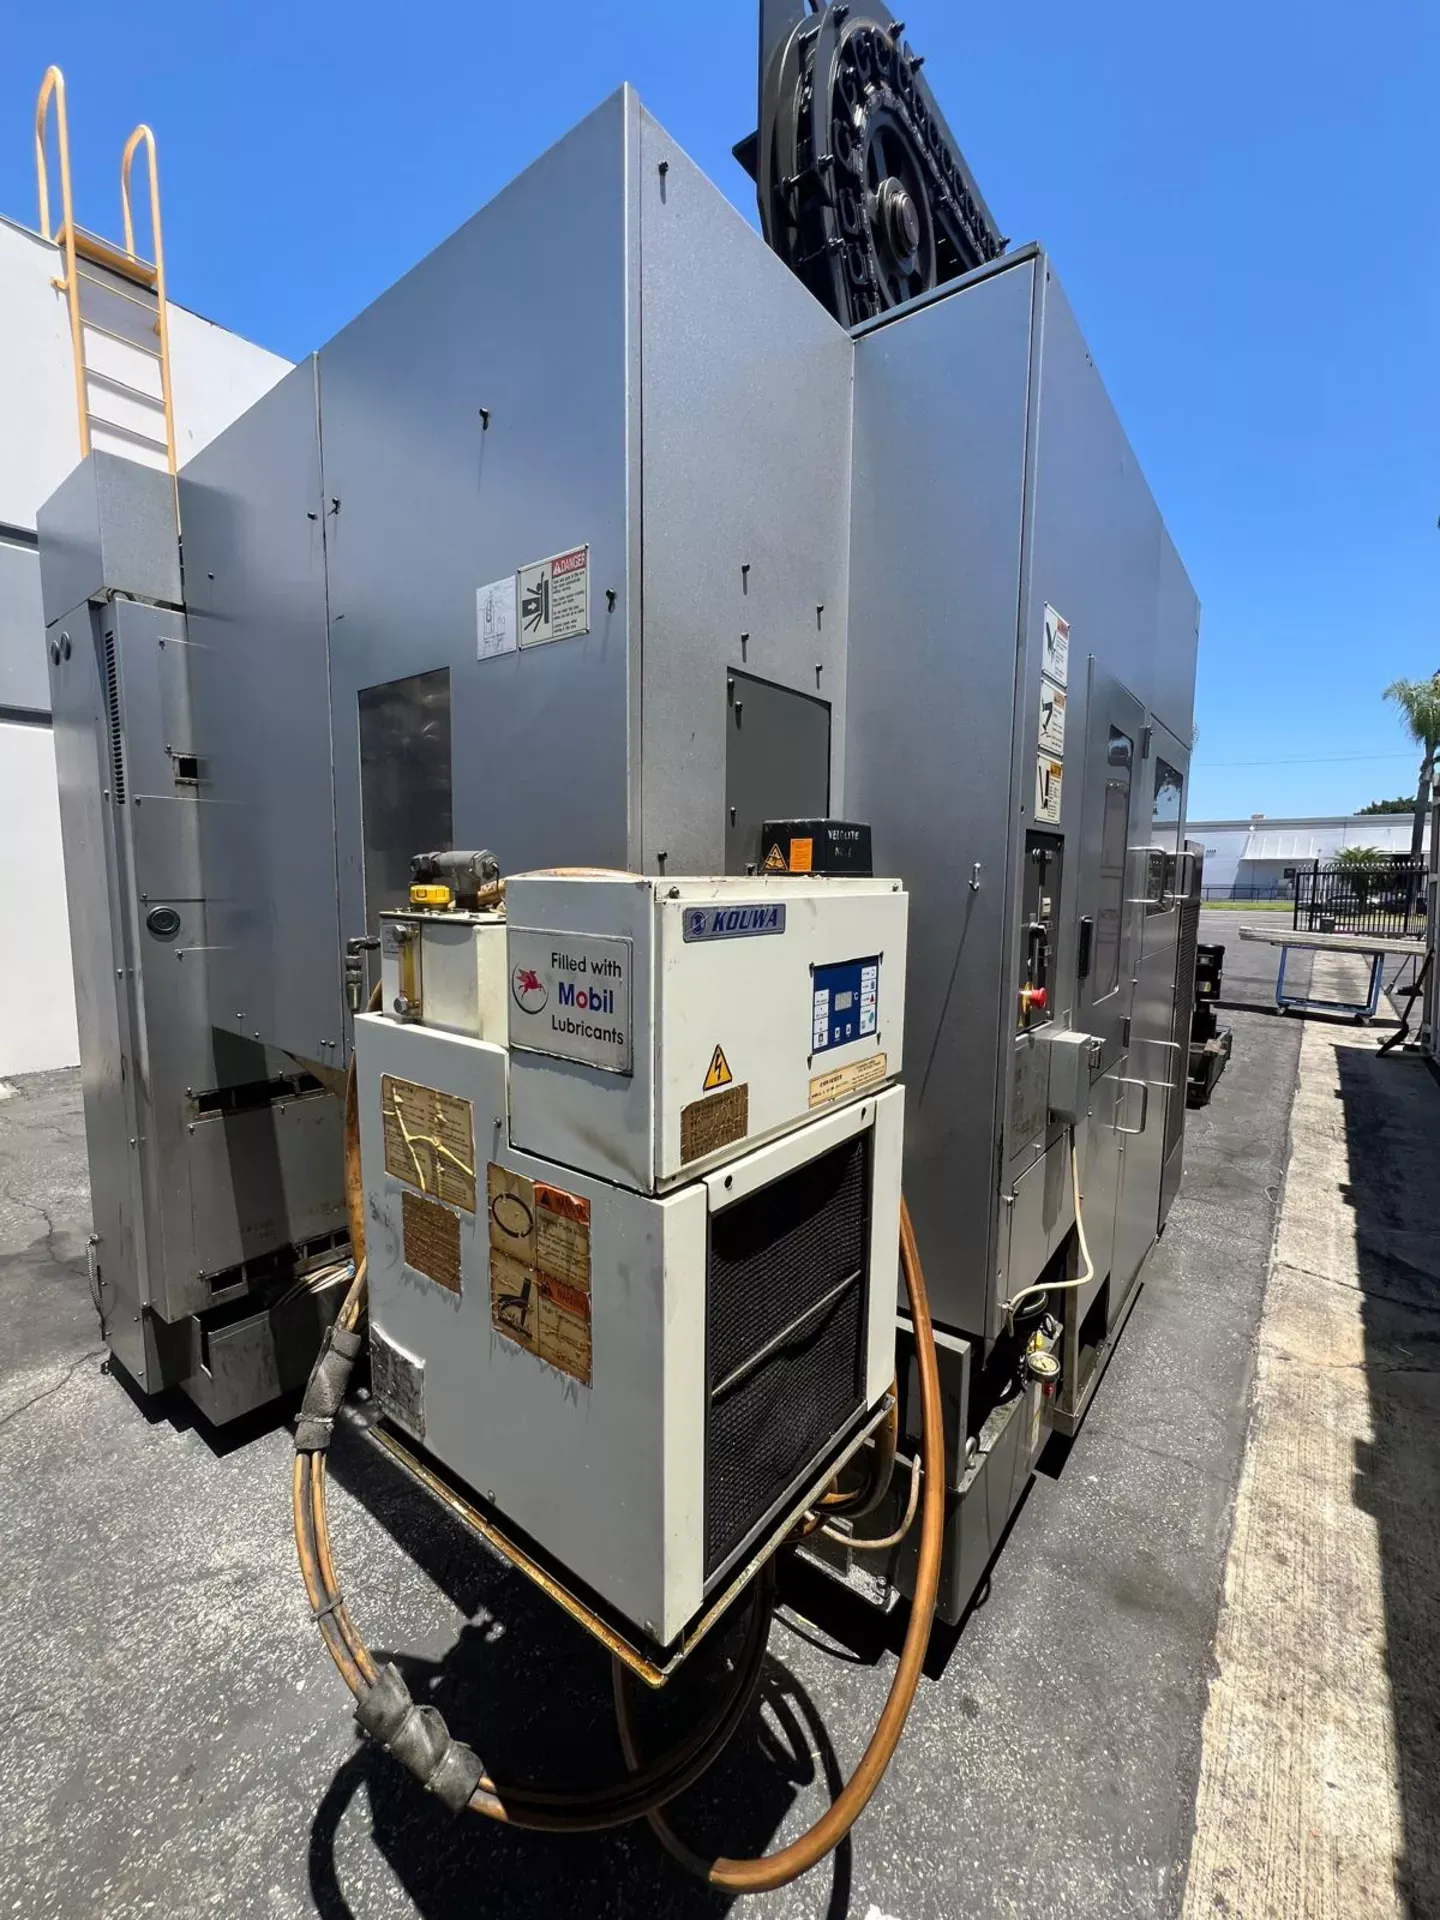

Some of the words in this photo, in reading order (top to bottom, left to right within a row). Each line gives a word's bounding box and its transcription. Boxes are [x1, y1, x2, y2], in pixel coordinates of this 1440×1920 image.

[712, 908, 778, 932] KOUWA
[551, 952, 587, 973] Filled
[590, 958, 622, 978] with
[558, 981, 614, 1014] Mobil
[552, 1014, 625, 1045] Lubricants
